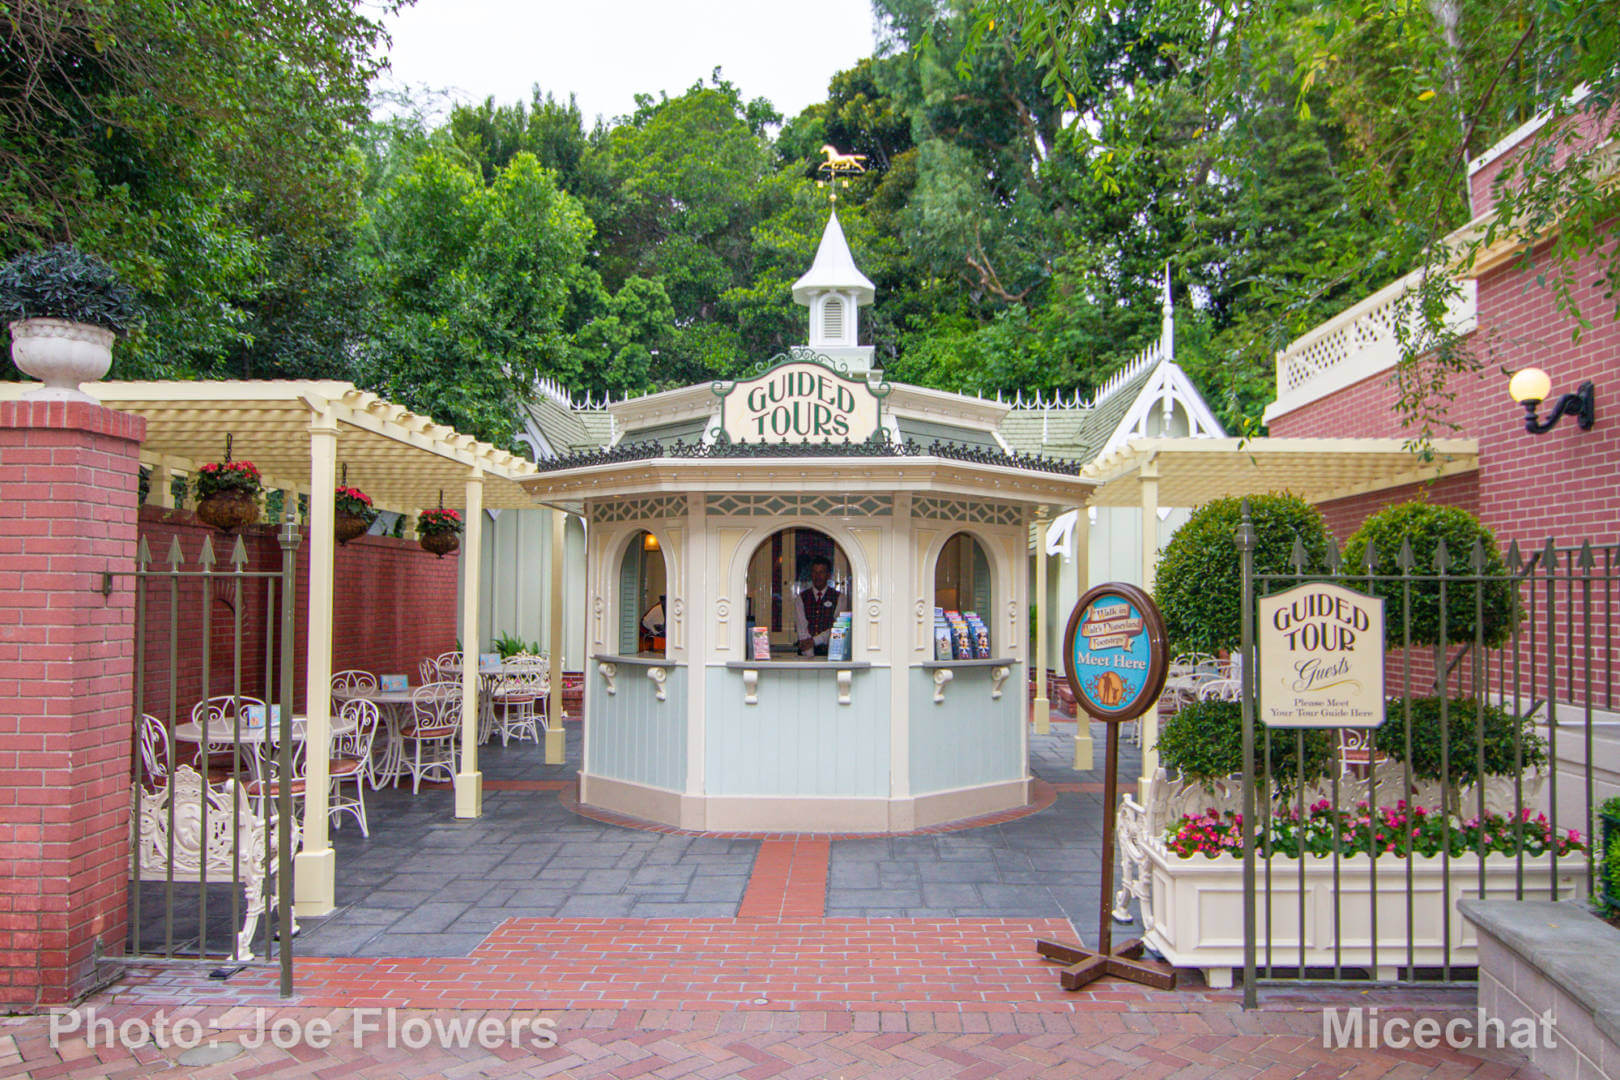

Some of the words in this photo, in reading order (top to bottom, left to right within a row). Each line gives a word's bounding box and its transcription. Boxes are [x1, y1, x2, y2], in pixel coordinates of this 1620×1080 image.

[748, 371, 855, 413] GUIDED
[752, 401, 850, 436] TOURS
[1273, 593, 1370, 632] GUIDED
[1283, 622, 1356, 651] TOUR
[1077, 651, 1110, 666] Meet
[1113, 654, 1147, 670] Here
[1293, 657, 1350, 693] Guests
[1271, 709, 1294, 718] Your
[1296, 709, 1320, 718] Tour
[1320, 709, 1348, 718] Guide
[1351, 709, 1373, 717] Here
[1327, 698, 1349, 707] Meet
